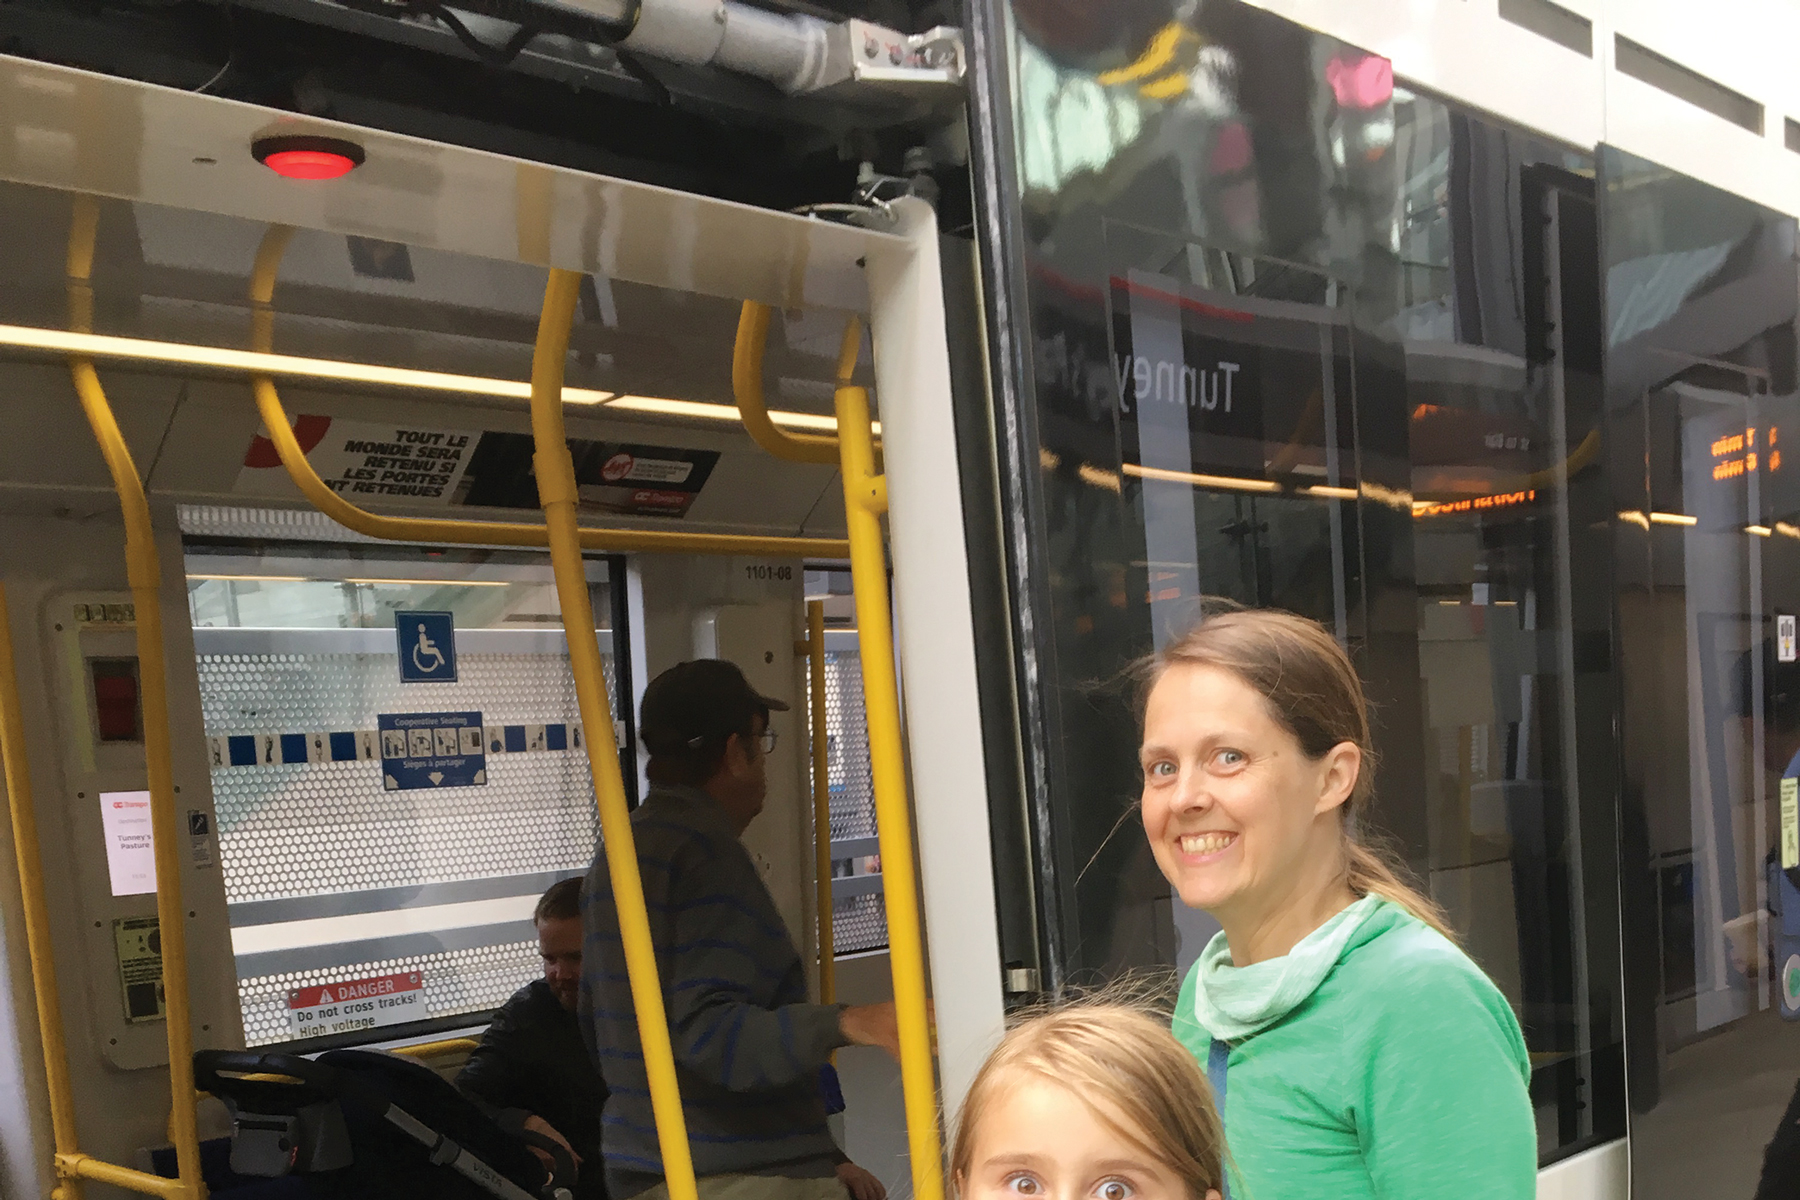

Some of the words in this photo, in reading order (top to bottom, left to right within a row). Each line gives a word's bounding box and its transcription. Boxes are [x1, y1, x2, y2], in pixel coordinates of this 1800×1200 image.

[396, 430, 444, 446] TOUT
[446, 435, 469, 447] LE
[343, 440, 415, 457] MONDE
[416, 446, 462, 460] SERA
[364, 456, 436, 472] RETENU
[438, 462, 457, 473] SI
[343, 467, 377, 480] LES
[380, 471, 450, 486] PORTES
[324, 478, 350, 492] NT
[352, 481, 444, 498] RETENUES
[745, 565, 792, 580] 1101-08
[394, 717, 439, 727] Cooperative
[440, 716, 468, 726] Seating
[434, 758, 466, 769] partager
[117, 833, 152, 842] Tunney's
[120, 842, 150, 850] Pasture
[338, 980, 395, 1000] DANGER
[297, 1011, 314, 1022] Do
[318, 1006, 339, 1019] not
[343, 1000, 374, 1015] cross
[378, 993, 417, 1009] tracks!
[299, 1023, 327, 1038] High
[331, 1016, 376, 1031] voltage
